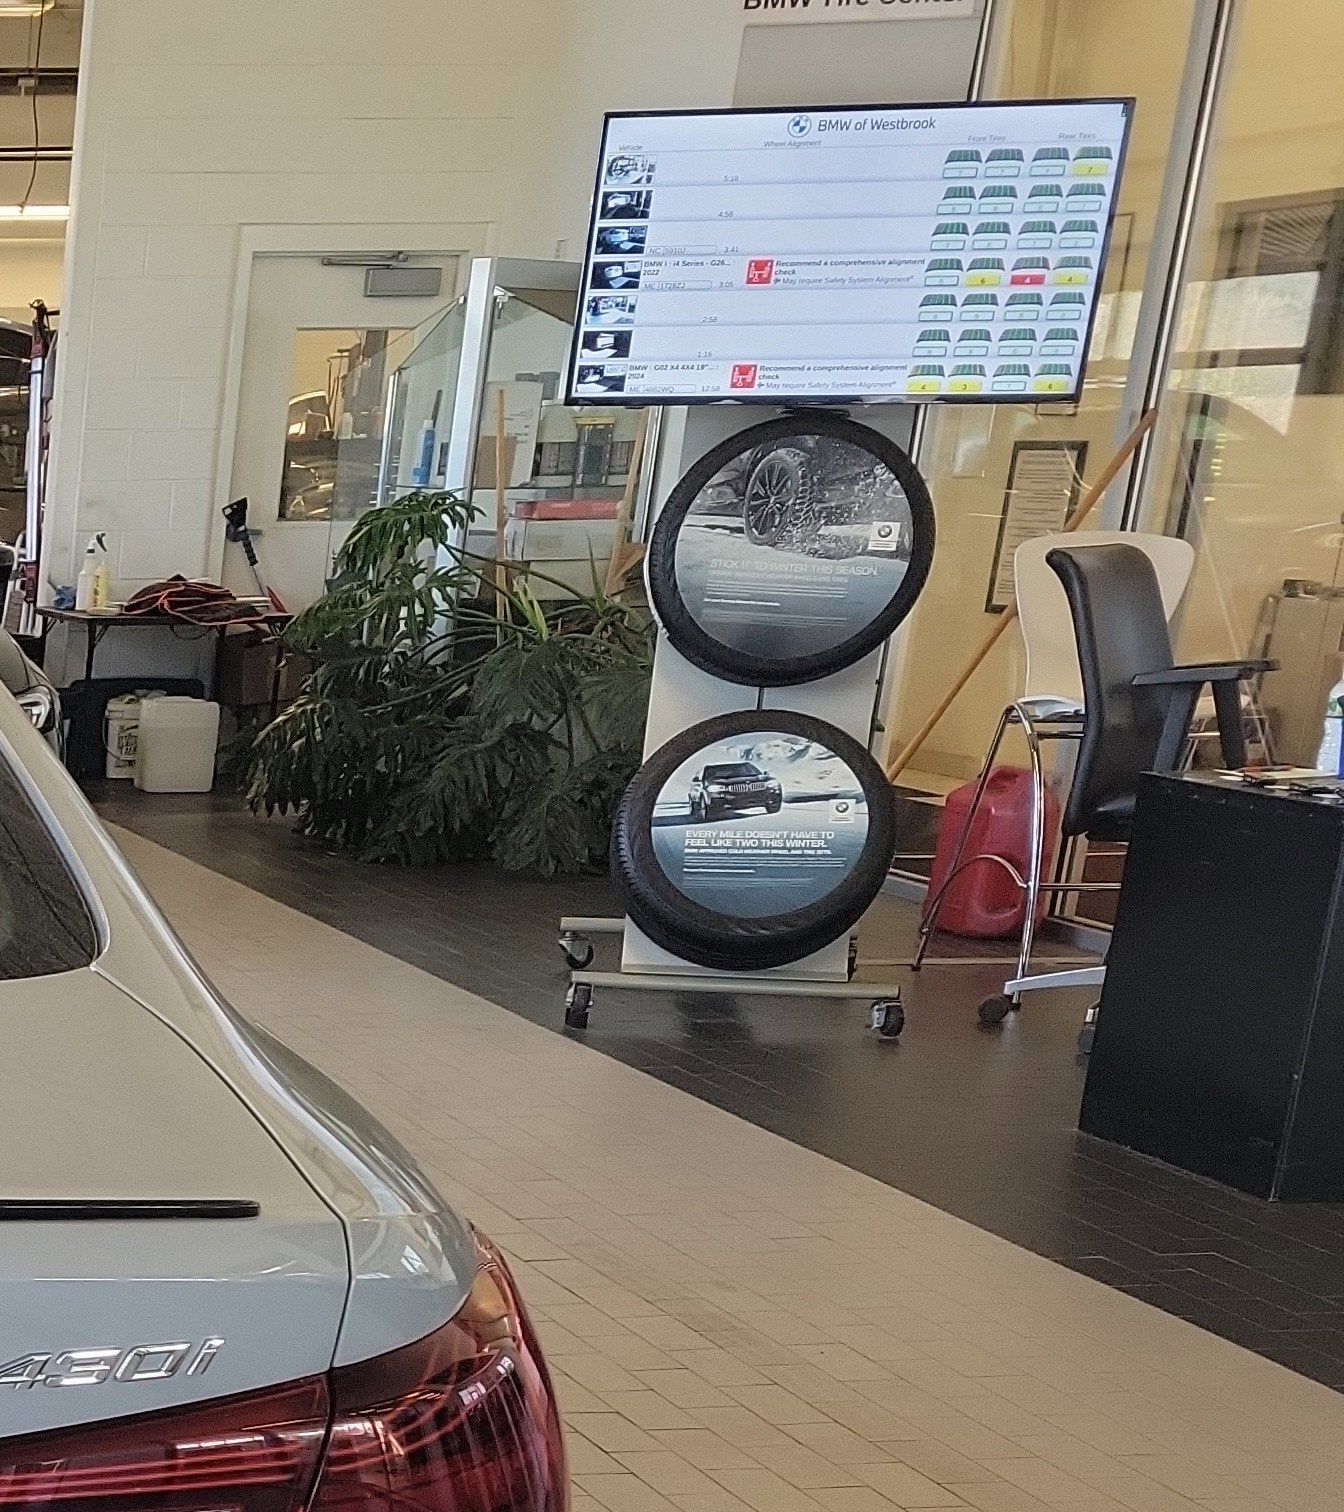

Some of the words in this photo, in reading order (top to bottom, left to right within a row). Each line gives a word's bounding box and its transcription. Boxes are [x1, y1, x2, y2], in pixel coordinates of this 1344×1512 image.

[817, 118, 852, 132] BMW
[854, 117, 868, 131] of
[870, 116, 937, 131] Westbrook
[787, 139, 822, 148] Alignment
[829, 260, 886, 268] comprehensive
[888, 259, 925, 268] alignment
[782, 278, 797, 286] May
[798, 277, 823, 285] require
[824, 277, 847, 285] Safety
[848, 276, 874, 285] System
[812, 364, 869, 373] comprehensive
[870, 364, 908, 373] alignment
[765, 382, 781, 390] May
[781, 381, 806, 390] require
[807, 382, 830, 390] Safety
[831, 381, 857, 389] System
[769, 562, 808, 573] WINTER
[810, 564, 834, 574] THIS
[685, 830, 716, 838] EVERY
[719, 830, 744, 838] MILE
[745, 831, 789, 839] DOESN'T
[790, 831, 820, 839] HAVE
[820, 831, 835, 839] TO
[684, 838, 709, 846] FEEL
[711, 839, 734, 847] LIKE
[735, 839, 759, 847] TWO
[760, 839, 784, 847] THIS
[785, 839, 827, 848] WINTER.
